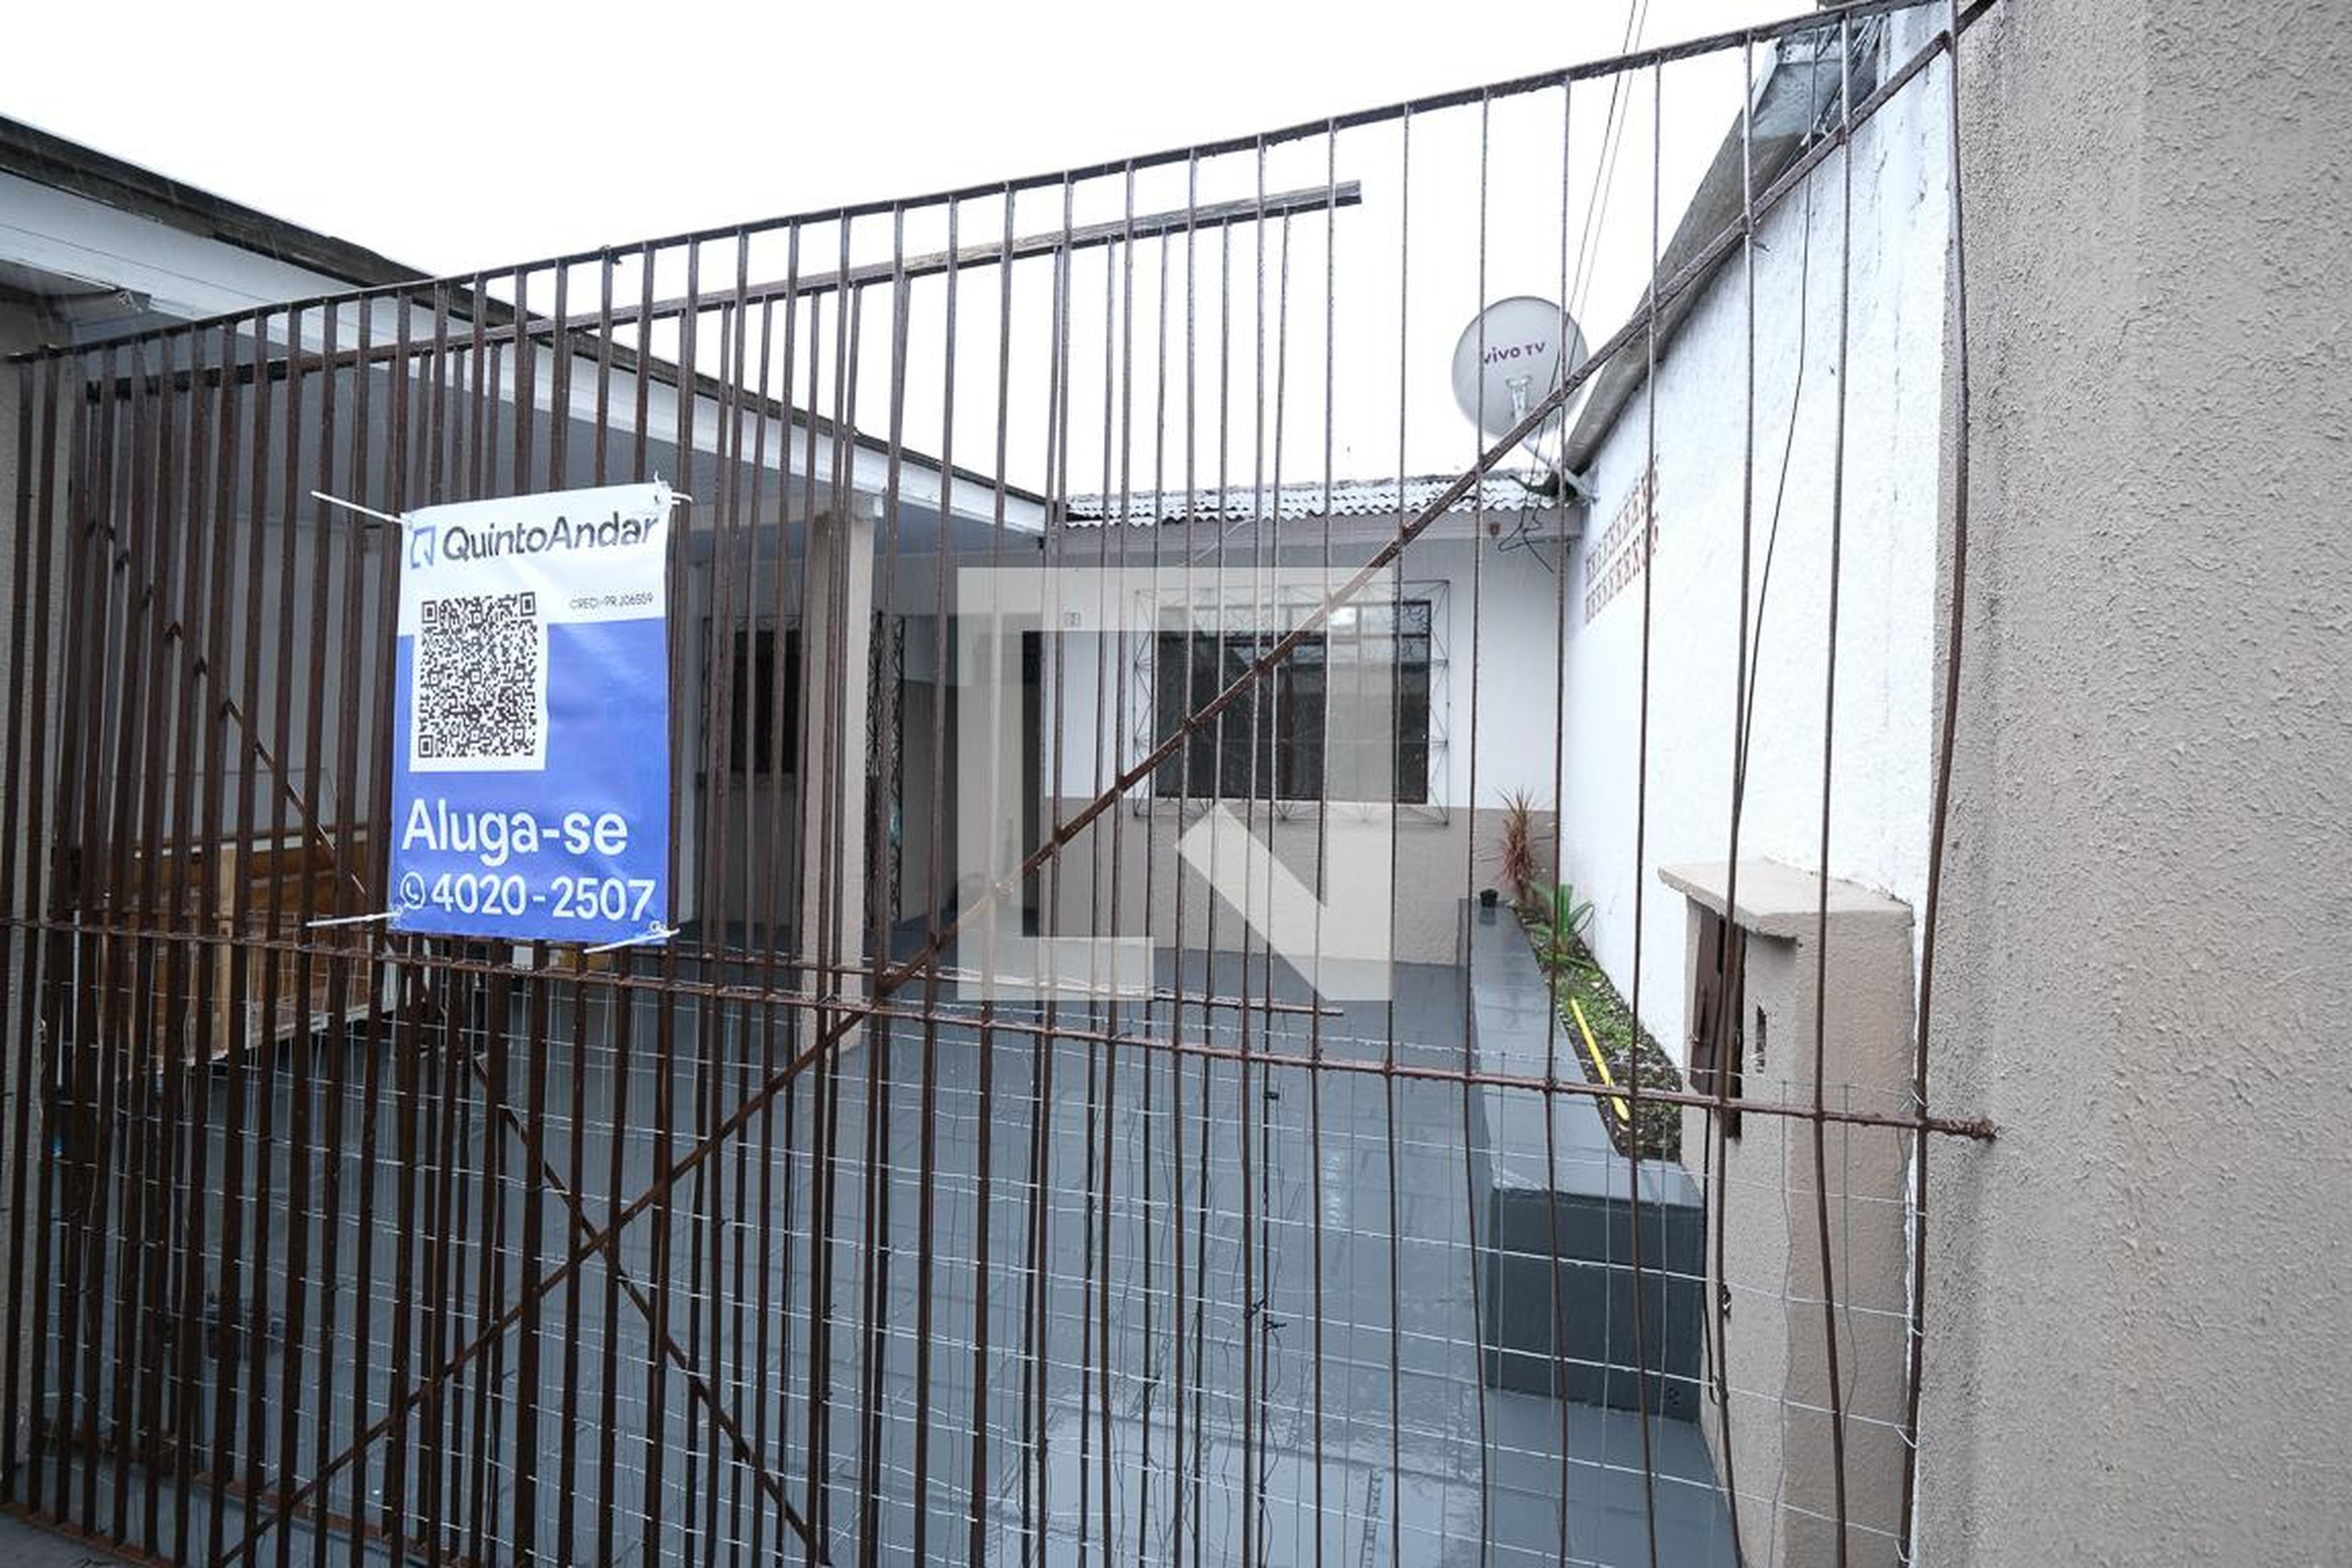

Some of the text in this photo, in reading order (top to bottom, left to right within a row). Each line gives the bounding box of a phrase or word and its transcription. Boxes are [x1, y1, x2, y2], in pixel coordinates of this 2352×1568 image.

[1484, 342, 1545, 364] vivo TV
[442, 511, 659, 562] QuintoAndar
[402, 799, 627, 866] Aluga-se
